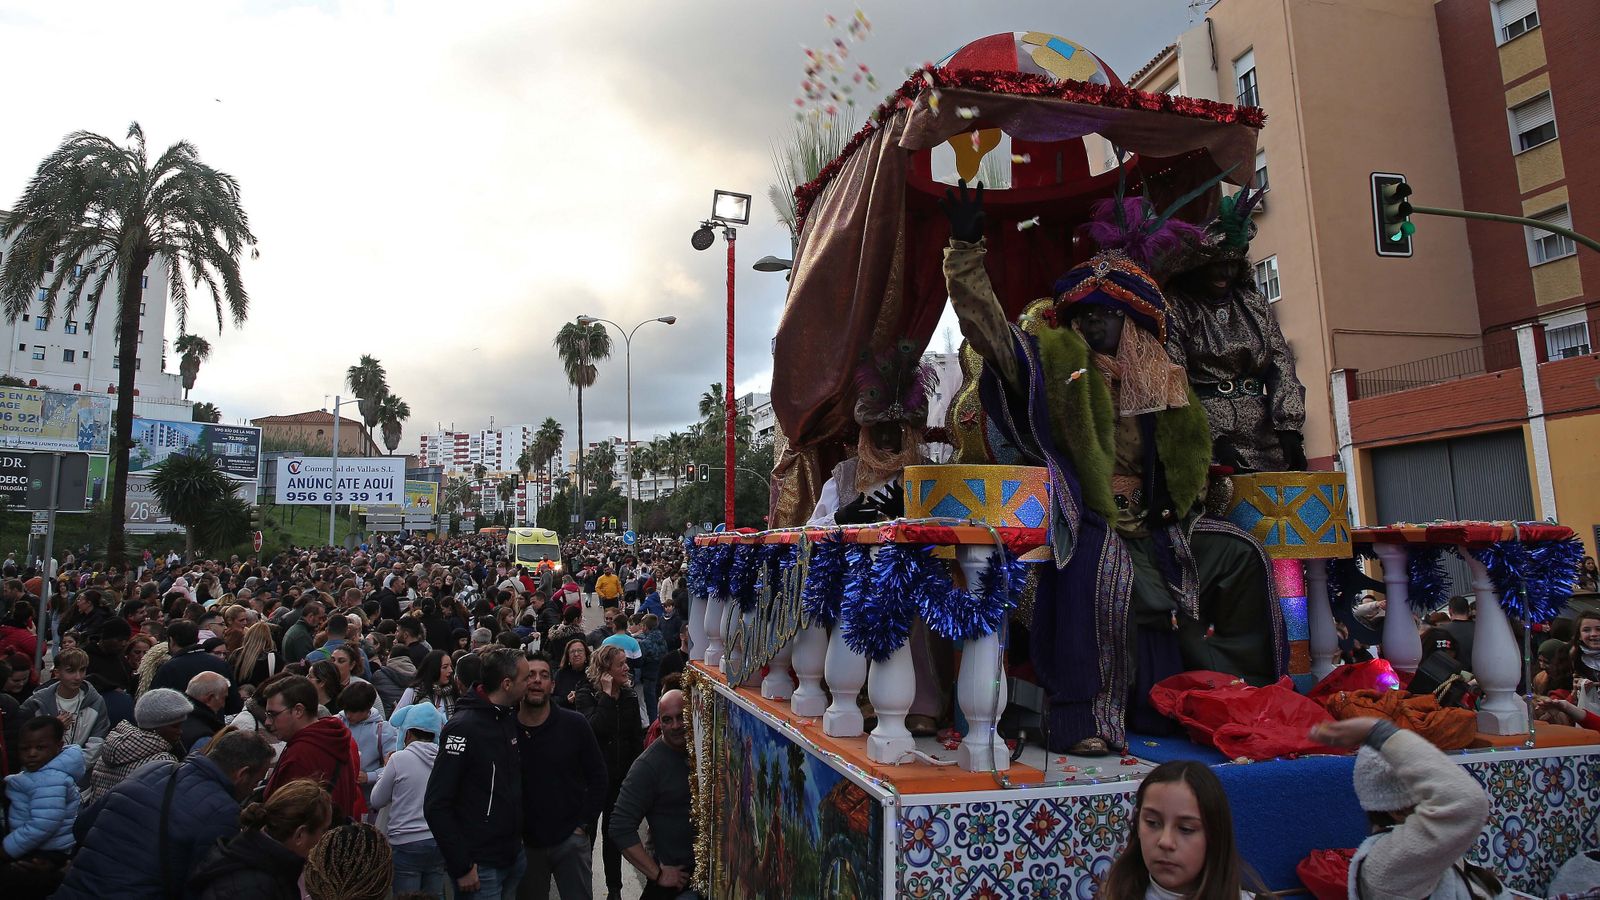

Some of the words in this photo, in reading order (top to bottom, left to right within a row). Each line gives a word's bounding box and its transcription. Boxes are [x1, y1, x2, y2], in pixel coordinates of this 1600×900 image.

[18, 413, 40, 423] 92
[3, 457, 27, 468] DR.
[305, 465, 344, 473] Comercal
[19, 476, 29, 484] C
[288, 475, 361, 489] ANÚNCATE
[363, 475, 394, 489] AQUÍ
[286, 492, 317, 501] 956
[323, 492, 344, 501] 63
[349, 492, 370, 501] 39
[375, 492, 393, 501] 11
[130, 501, 149, 520] 26
